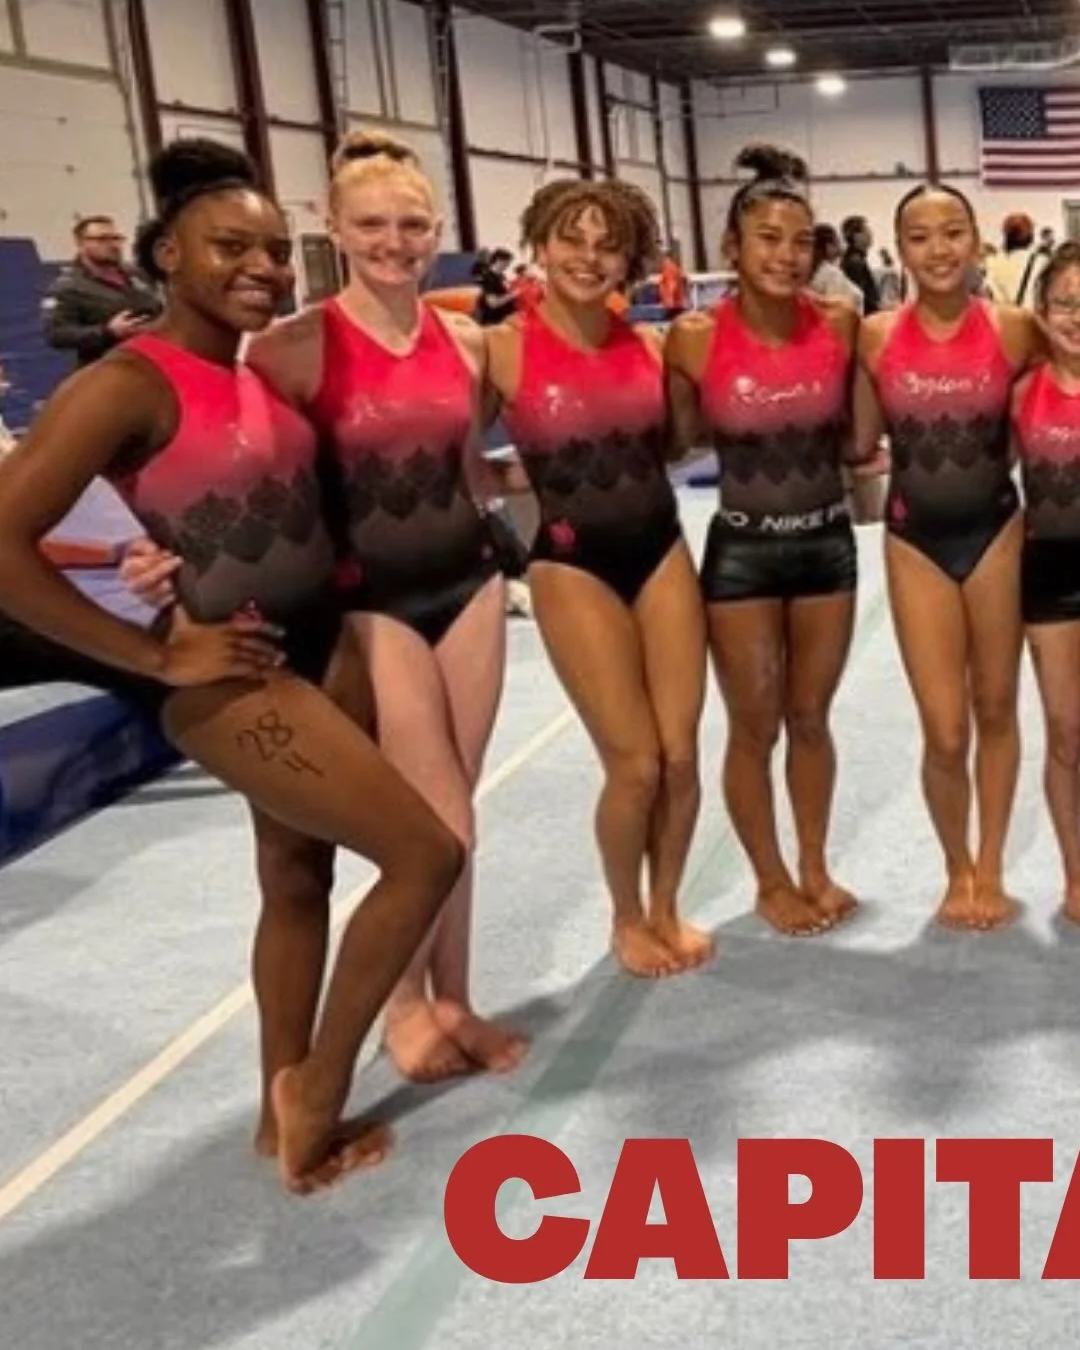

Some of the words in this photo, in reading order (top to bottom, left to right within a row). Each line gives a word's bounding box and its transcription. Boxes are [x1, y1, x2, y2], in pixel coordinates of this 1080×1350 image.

[759, 508, 825, 532] NIKE
[235, 709, 293, 763] 28
[283, 750, 325, 779] 4
